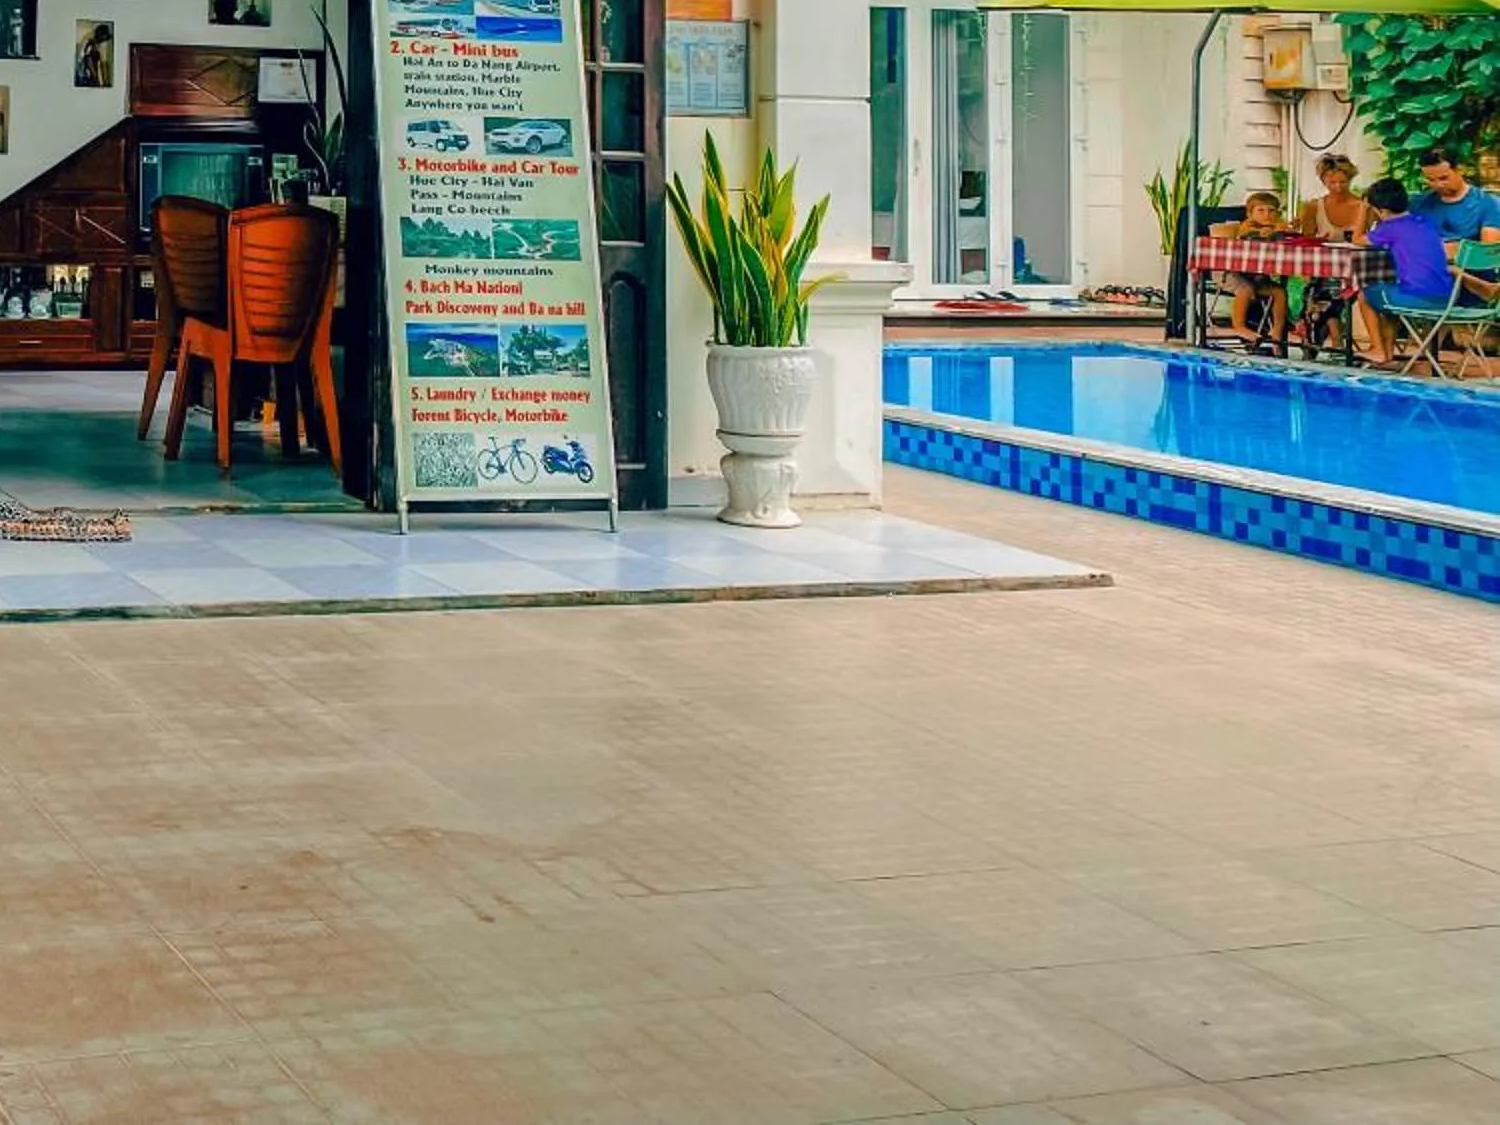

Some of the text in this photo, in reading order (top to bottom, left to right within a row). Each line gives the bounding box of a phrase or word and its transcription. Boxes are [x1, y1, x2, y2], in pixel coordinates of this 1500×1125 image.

[390, 43, 405, 54] 2.
[410, 43, 437, 55] Car
[453, 44, 487, 57] Mini
[492, 45, 519, 57] bus
[499, 87, 522, 98] City
[398, 158, 579, 175] 3. Motorbike and Car Tour
[441, 175, 468, 188] City
[510, 177, 534, 187] Van
[412, 204, 443, 215] Lang
[425, 264, 479, 276] Monkey
[404, 280, 416, 293] 4.
[420, 280, 450, 293] Bach
[454, 281, 473, 294] Ma
[406, 301, 433, 314] Park
[502, 302, 525, 315] and
[411, 387, 423, 400] 5.
[427, 387, 476, 402] Laundry
[491, 388, 548, 403] Exchange
[551, 390, 590, 403] money
[505, 409, 569, 422] Motorbike
